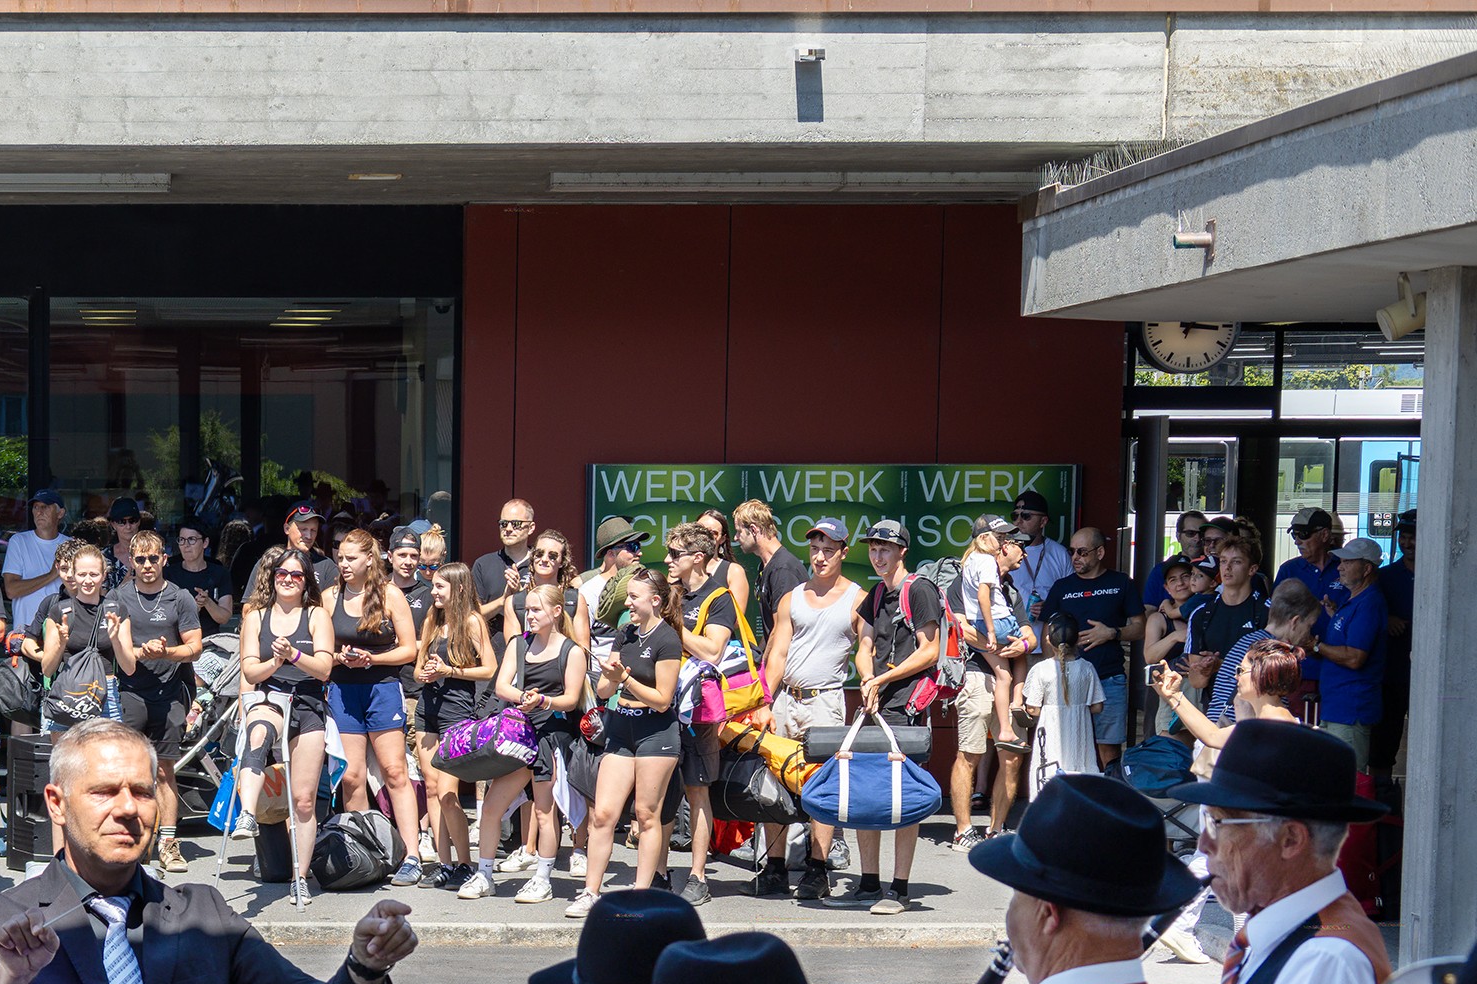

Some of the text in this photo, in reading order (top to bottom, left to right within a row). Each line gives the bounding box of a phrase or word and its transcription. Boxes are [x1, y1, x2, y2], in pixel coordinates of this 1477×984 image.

[600, 470, 726, 502] WERK
[759, 470, 885, 502] WERK
[918, 470, 1044, 502] WERK
[1062, 588, 1119, 600] JACK JONES
[620, 708, 644, 716] PRO
